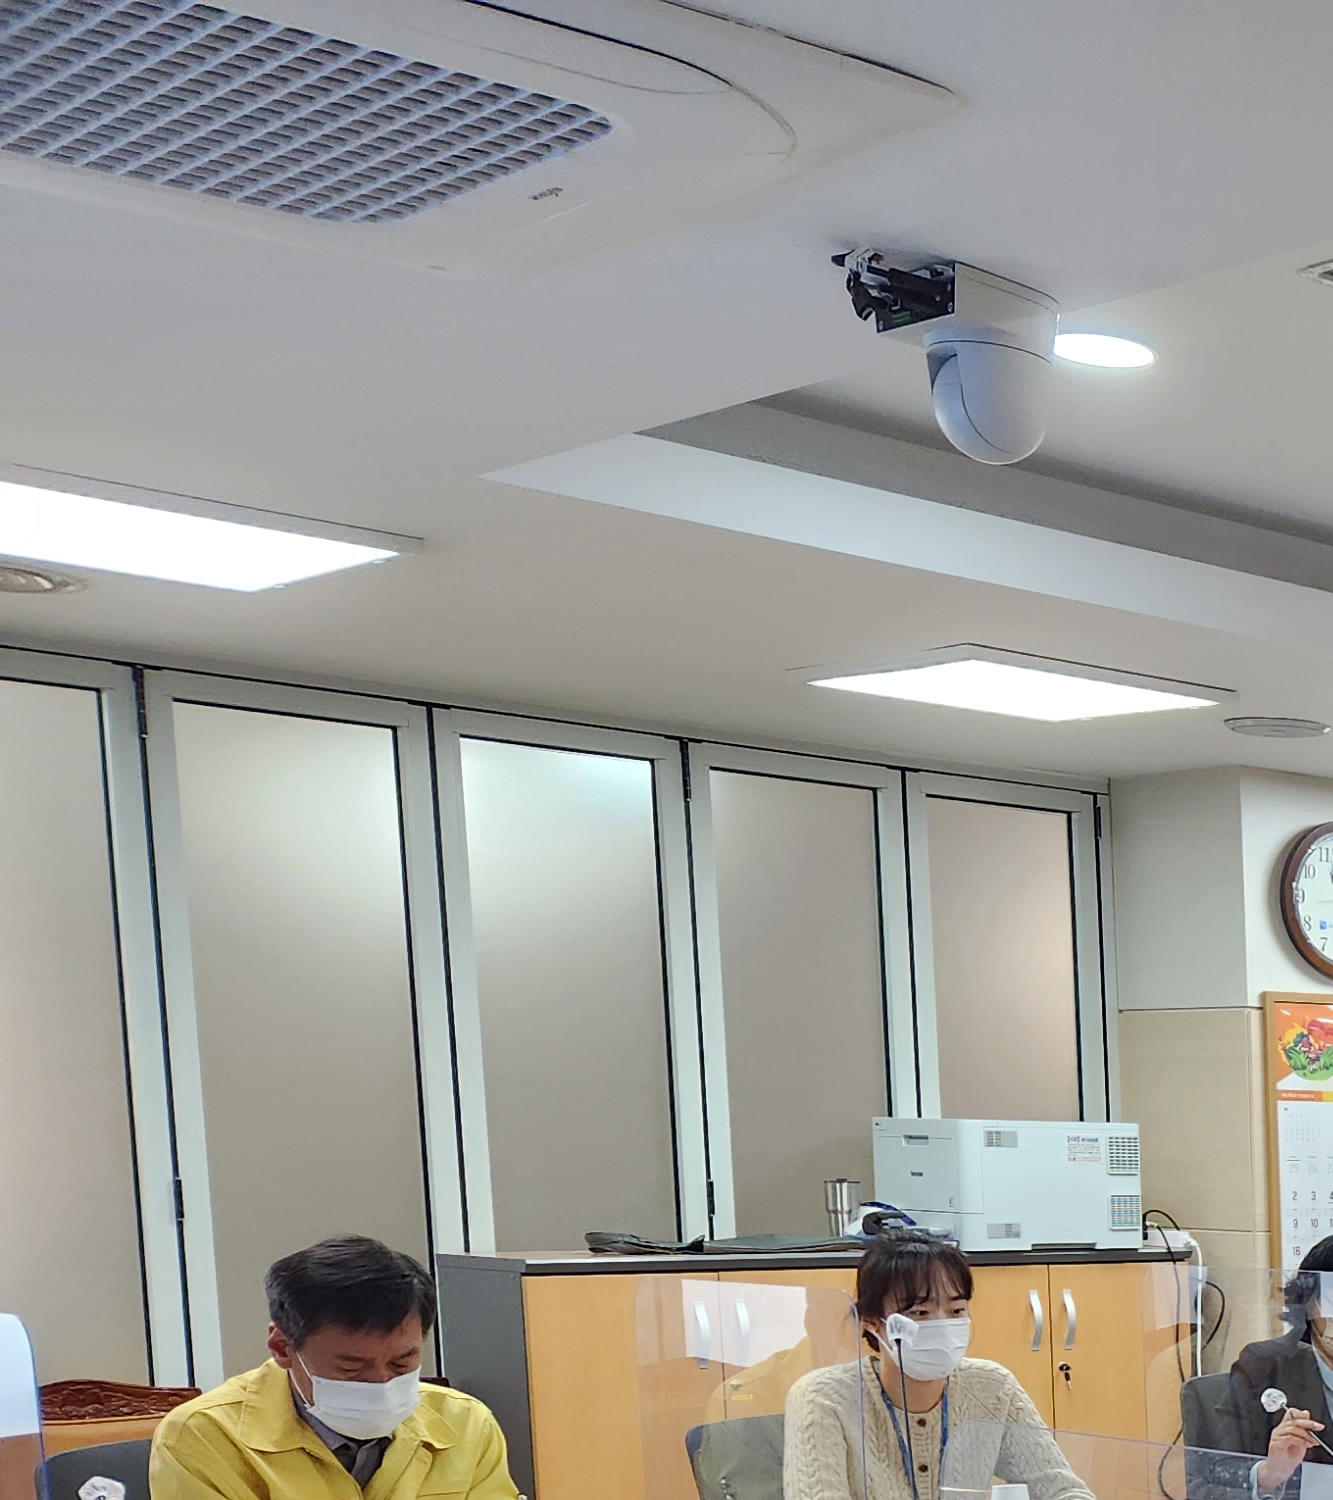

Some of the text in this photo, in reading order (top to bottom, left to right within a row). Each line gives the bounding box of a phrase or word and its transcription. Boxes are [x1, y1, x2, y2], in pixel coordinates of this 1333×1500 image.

[1319, 847, 1329, 863] 11
[1303, 864, 1316, 880] 10
[1303, 915, 1312, 931] 8
[1320, 937, 1328, 952] 7
[1289, 1164, 1299, 1174] 25
[1308, 1164, 1318, 1174] 26
[1292, 1191, 1298, 1201] 2
[1311, 1191, 1316, 1201] 3
[1293, 1218, 1298, 1229] 9
[1310, 1218, 1318, 1228] 10
[1292, 1246, 1301, 1256] 16
